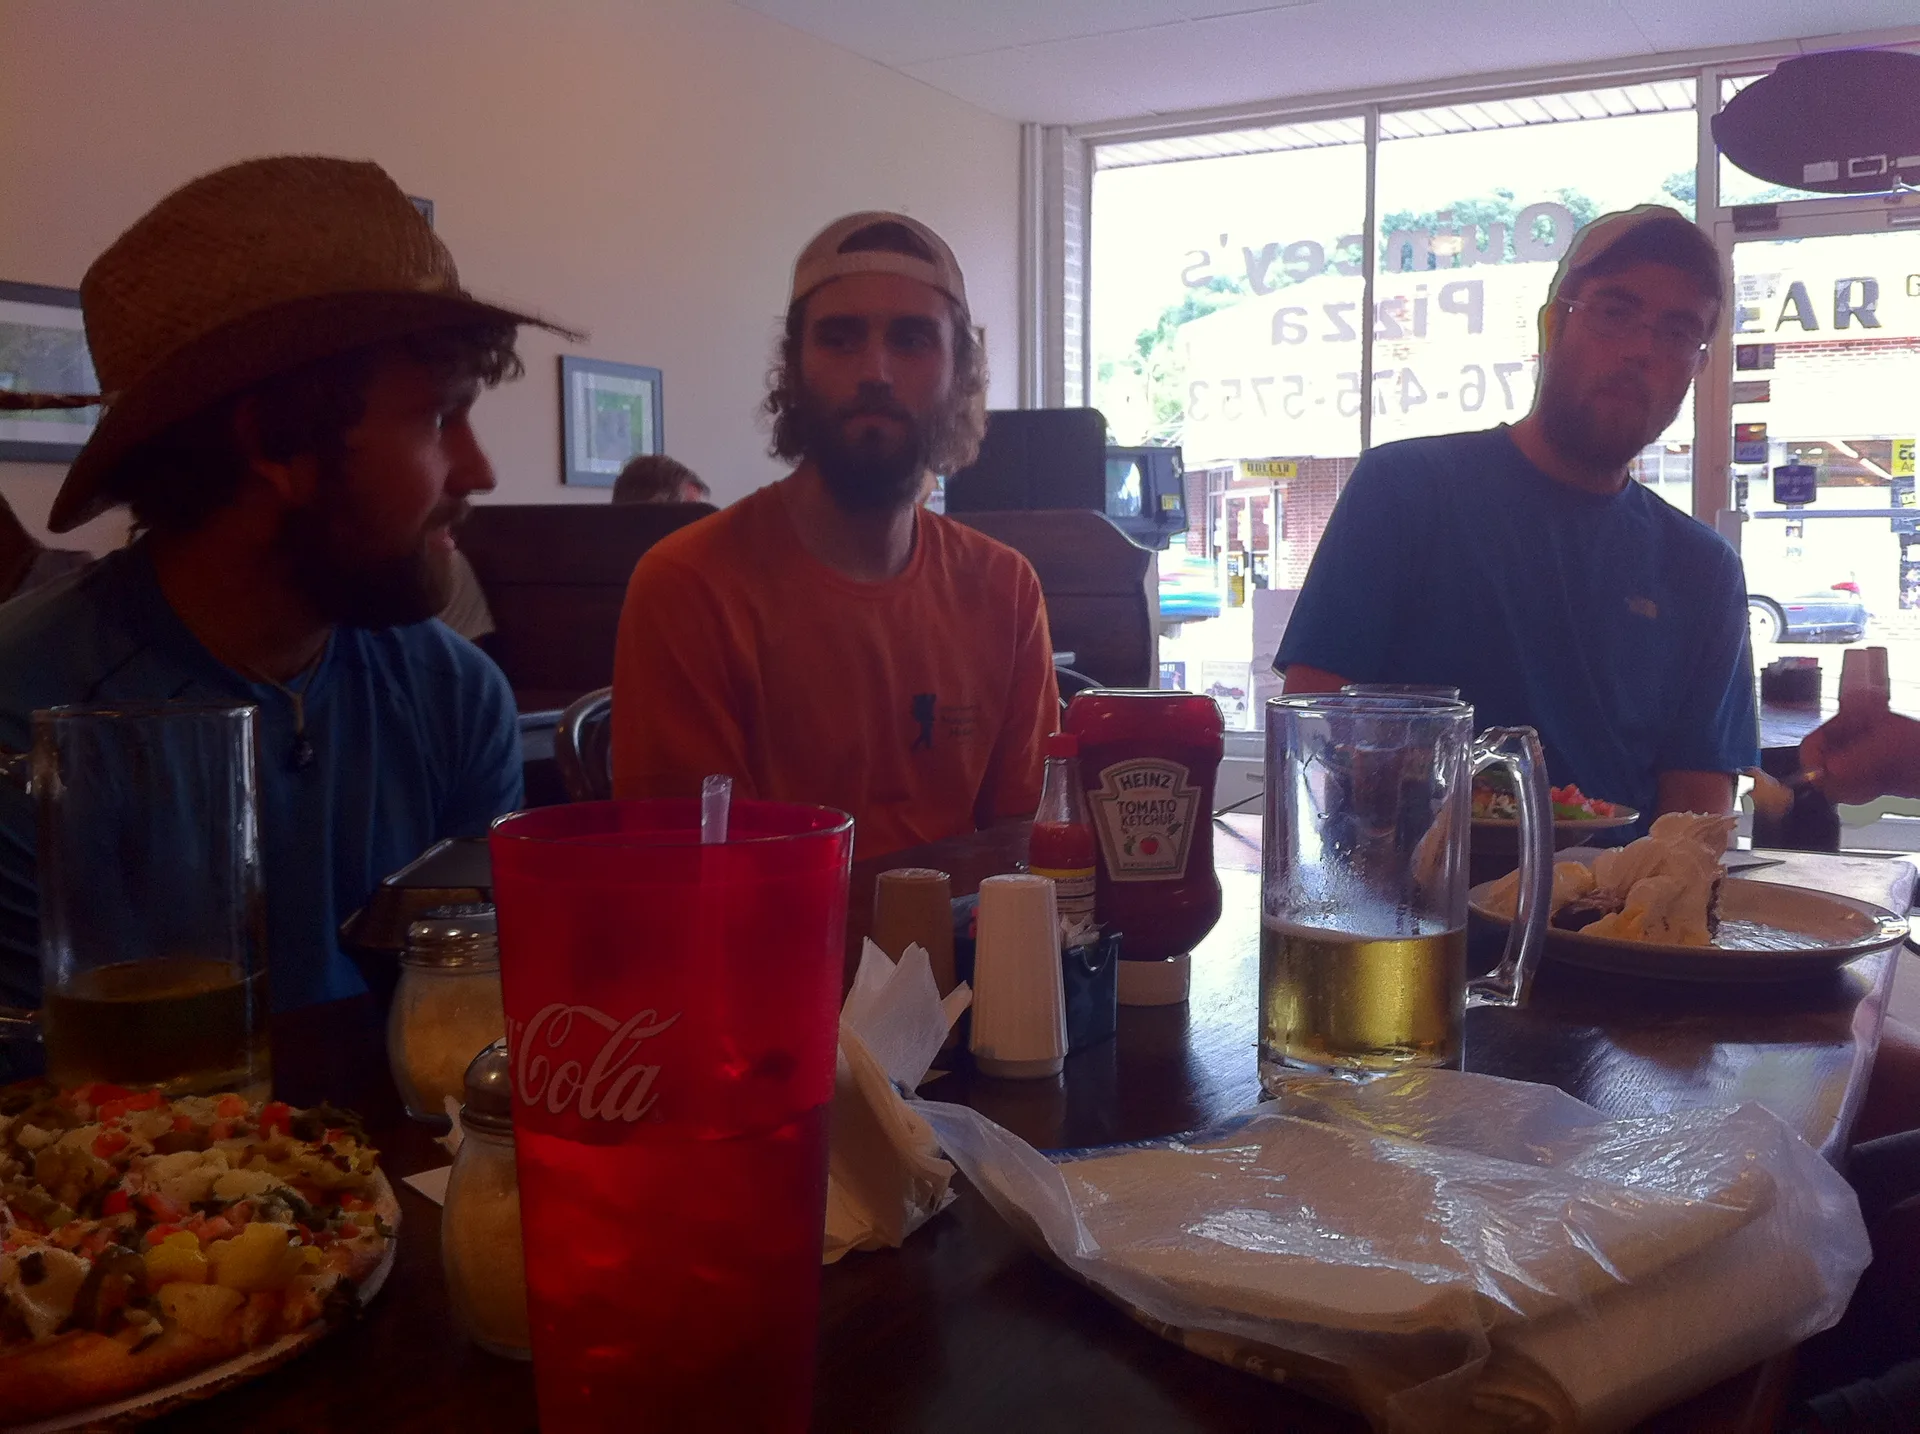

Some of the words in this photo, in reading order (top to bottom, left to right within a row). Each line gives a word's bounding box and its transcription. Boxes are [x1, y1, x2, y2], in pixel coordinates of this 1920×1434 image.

[1119, 772, 1173, 790] HEINZ
[1117, 800, 1177, 815] TOMATO
[1121, 812, 1176, 827] KETCHUP
